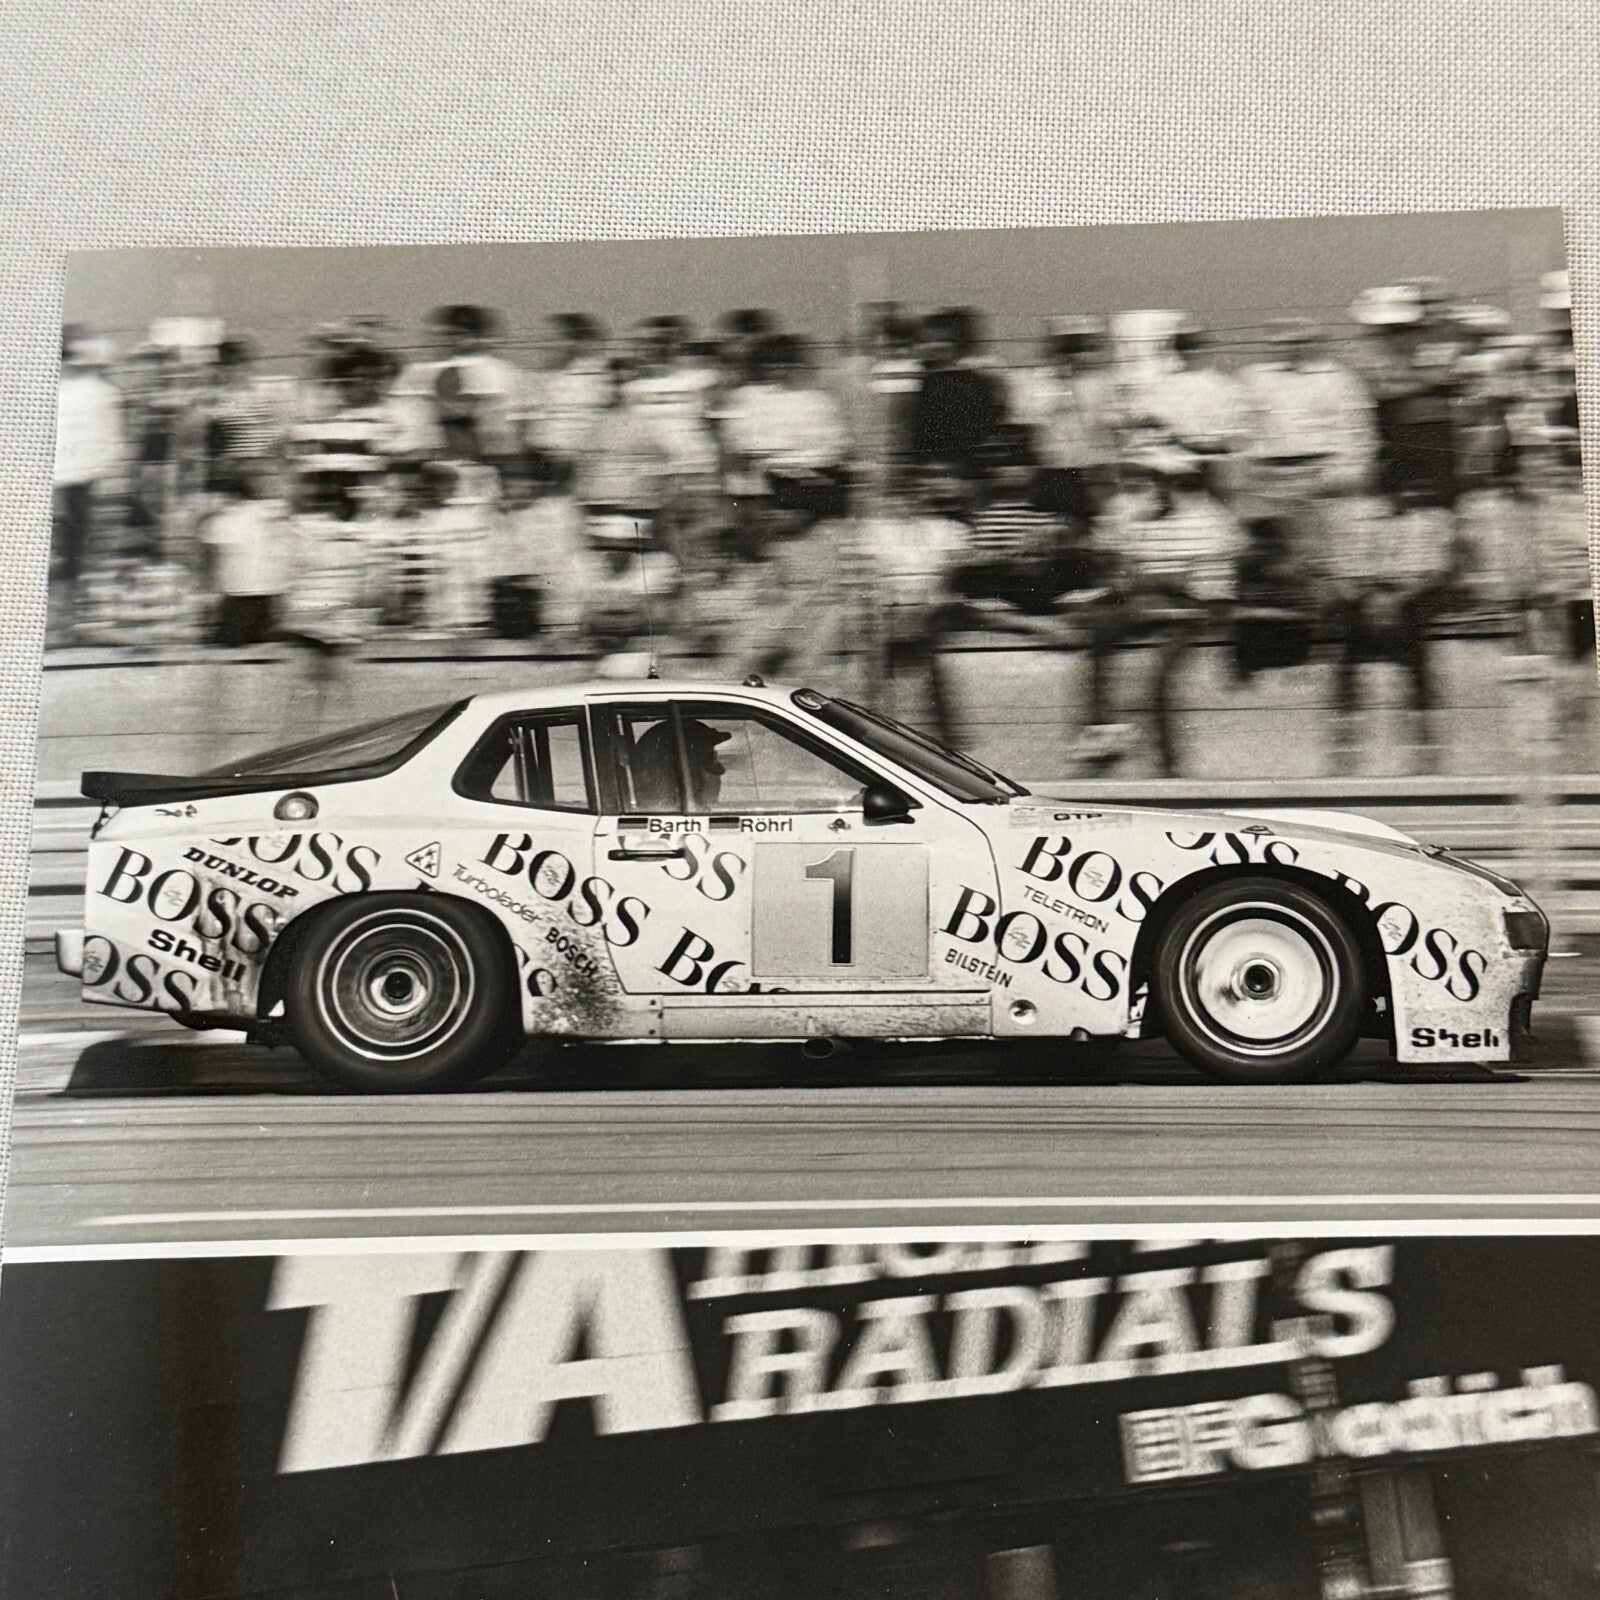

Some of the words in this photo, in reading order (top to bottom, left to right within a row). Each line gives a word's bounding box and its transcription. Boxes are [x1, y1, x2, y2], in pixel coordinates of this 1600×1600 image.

[649, 818, 702, 833] Barth
[740, 818, 793, 832] Röhrl
[183, 847, 300, 899] DUNLOP
[478, 833, 651, 947] BOSS
[97, 846, 283, 955] BOSS
[805, 848, 852, 964] 1
[1024, 885, 1110, 934] TELETRON
[148, 928, 246, 982] Shell
[546, 926, 599, 978] BOSCH
[939, 884, 1128, 1001] BOSS
[945, 948, 1013, 988] BILSTEIN
[708, 1244, 1395, 1423] RADIALS
